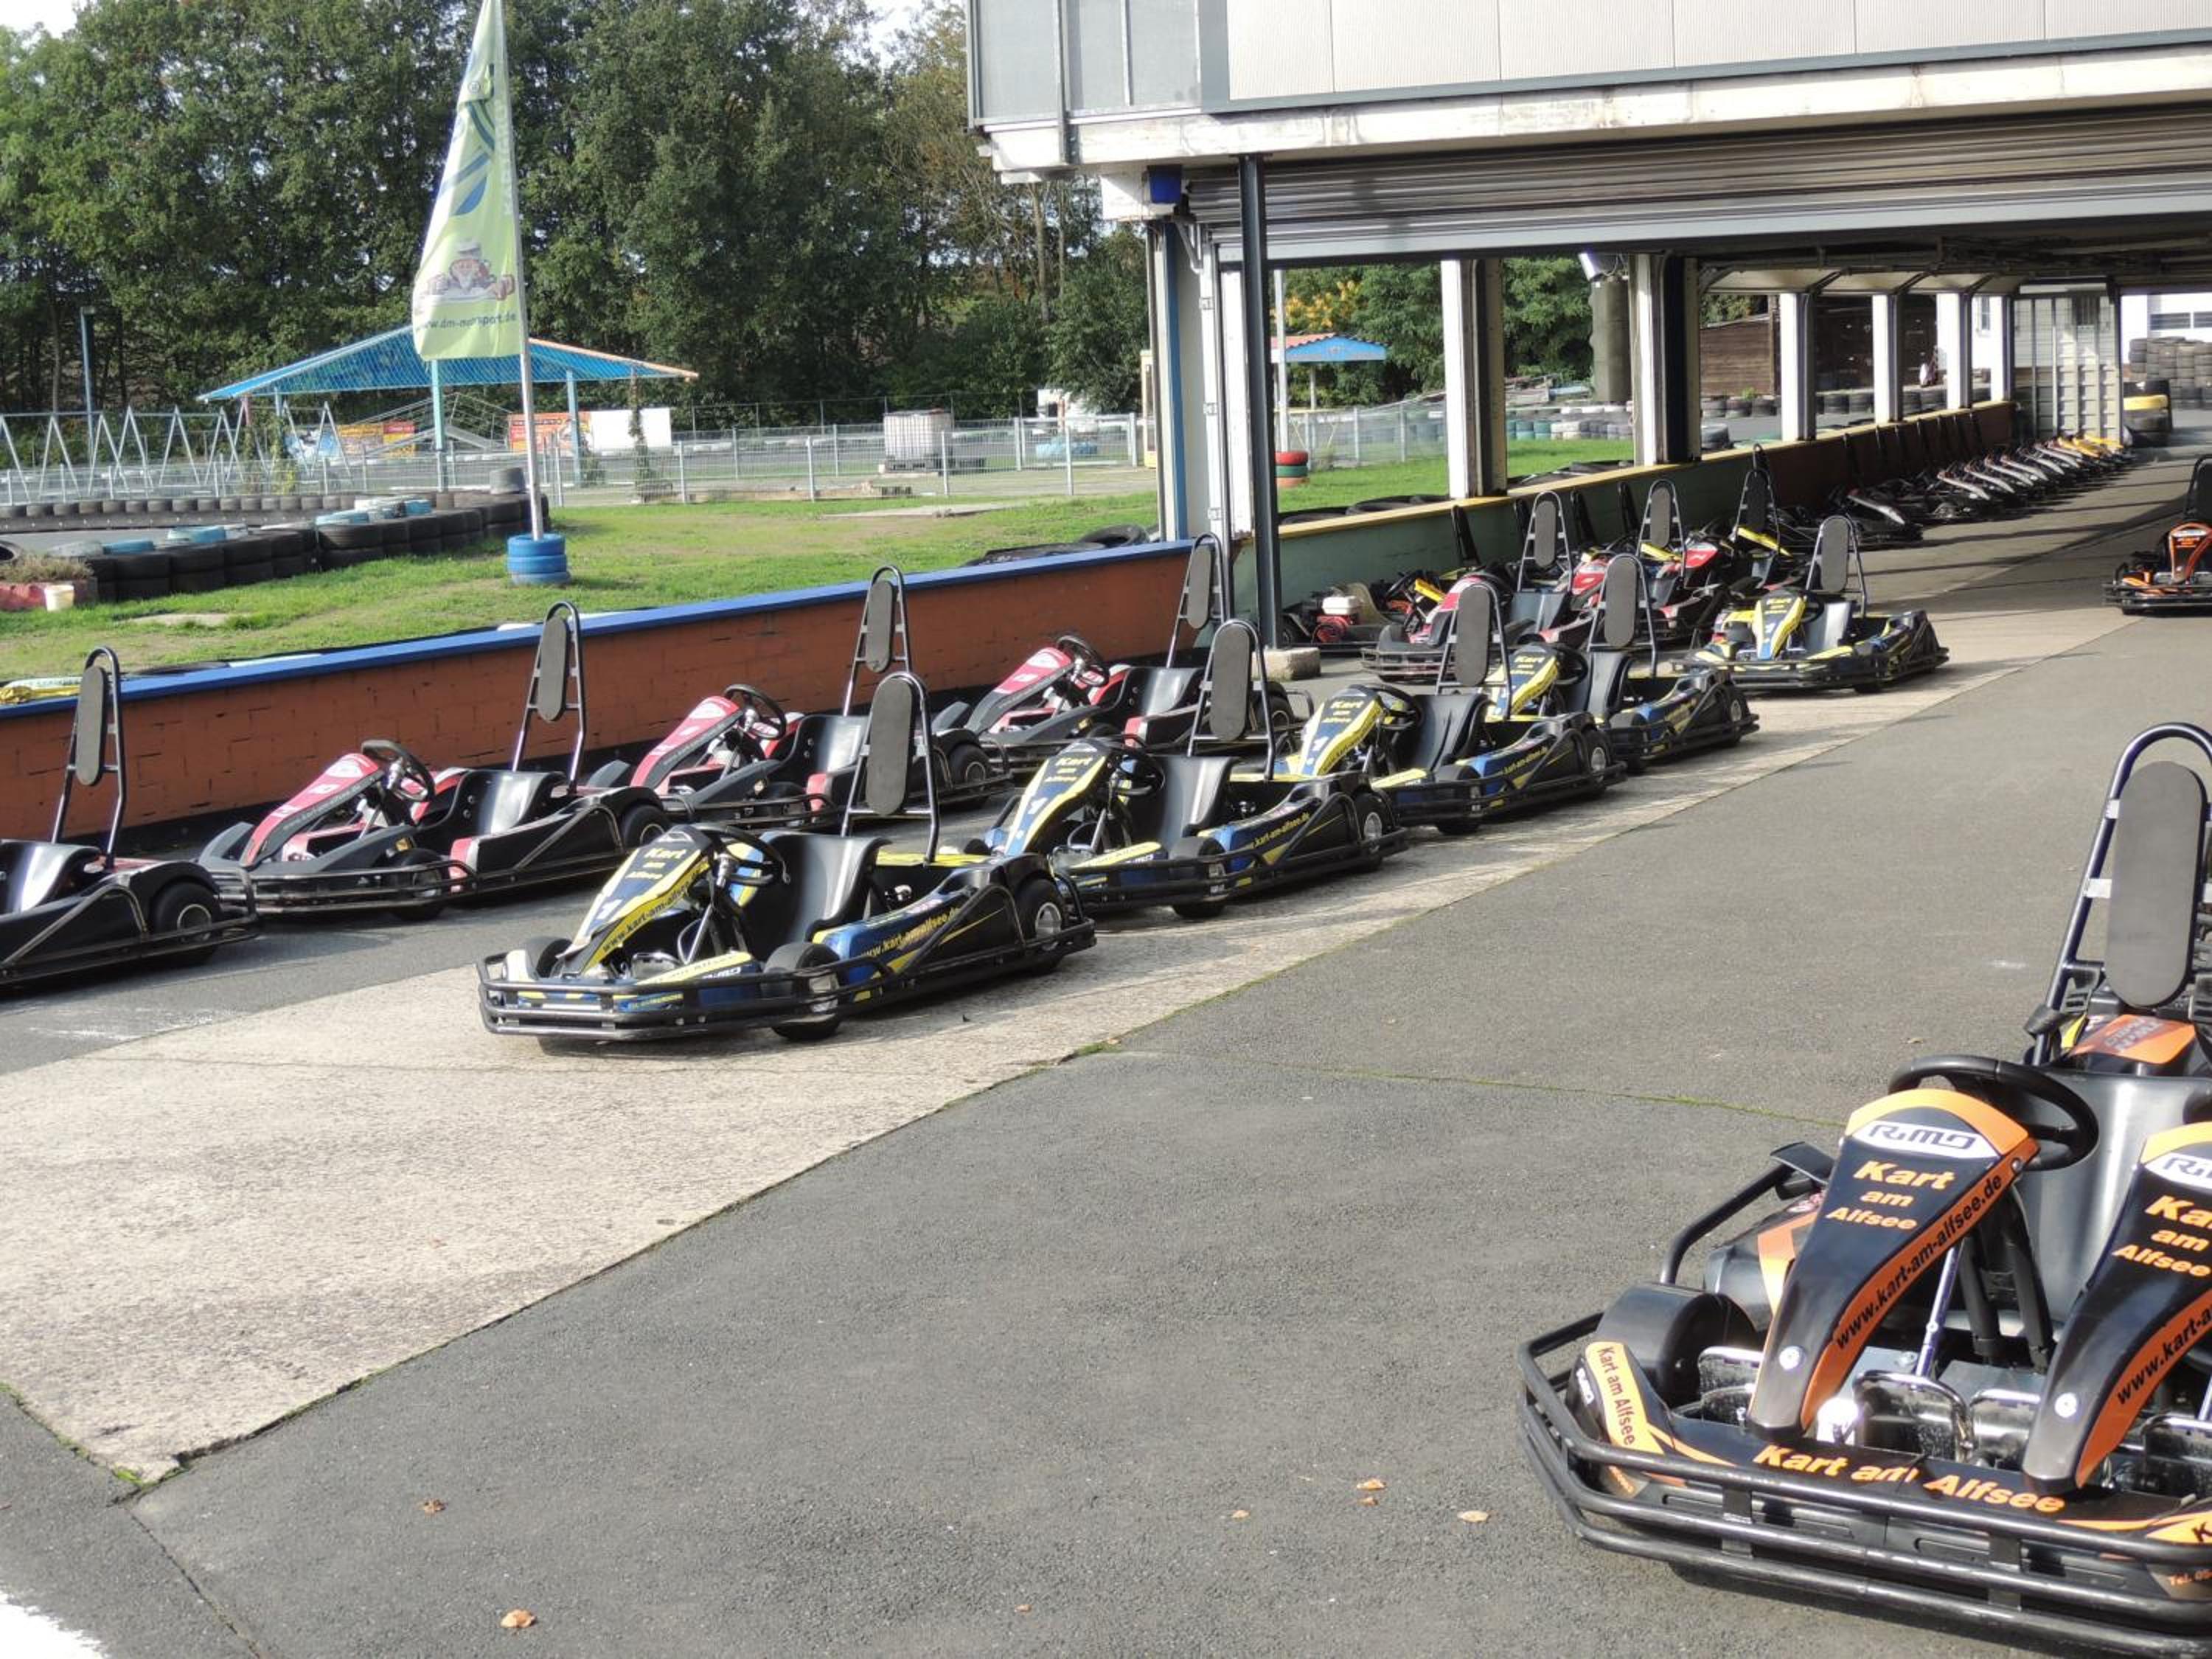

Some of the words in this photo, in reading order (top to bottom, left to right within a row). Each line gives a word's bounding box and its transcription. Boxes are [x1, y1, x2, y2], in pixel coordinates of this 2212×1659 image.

[1055, 757, 1093, 766] Kart
[644, 847, 687, 859] Kart
[1852, 1160, 1955, 1191] Kart
[1860, 1190, 1914, 1207] am
[2145, 1194, 2212, 1230] Ka
[1825, 1206, 1917, 1231] Alfsee
[2150, 1228, 2211, 1252] am
[1837, 1175, 2002, 1349] www.kart-am-alfsee.de
[2112, 1243, 2212, 1278] Alfsee
[1597, 1346, 1619, 1373] Kart
[2117, 1303, 2212, 1405] www.kart-a
[1607, 1374, 1624, 1396] am
[1614, 1398, 1644, 1446] Alfsee
[1752, 1444, 1849, 1477] Kart
[1850, 1464, 1919, 1484] am
[1923, 1475, 2065, 1514] Alfsee
[2191, 1521, 2212, 1543] K
